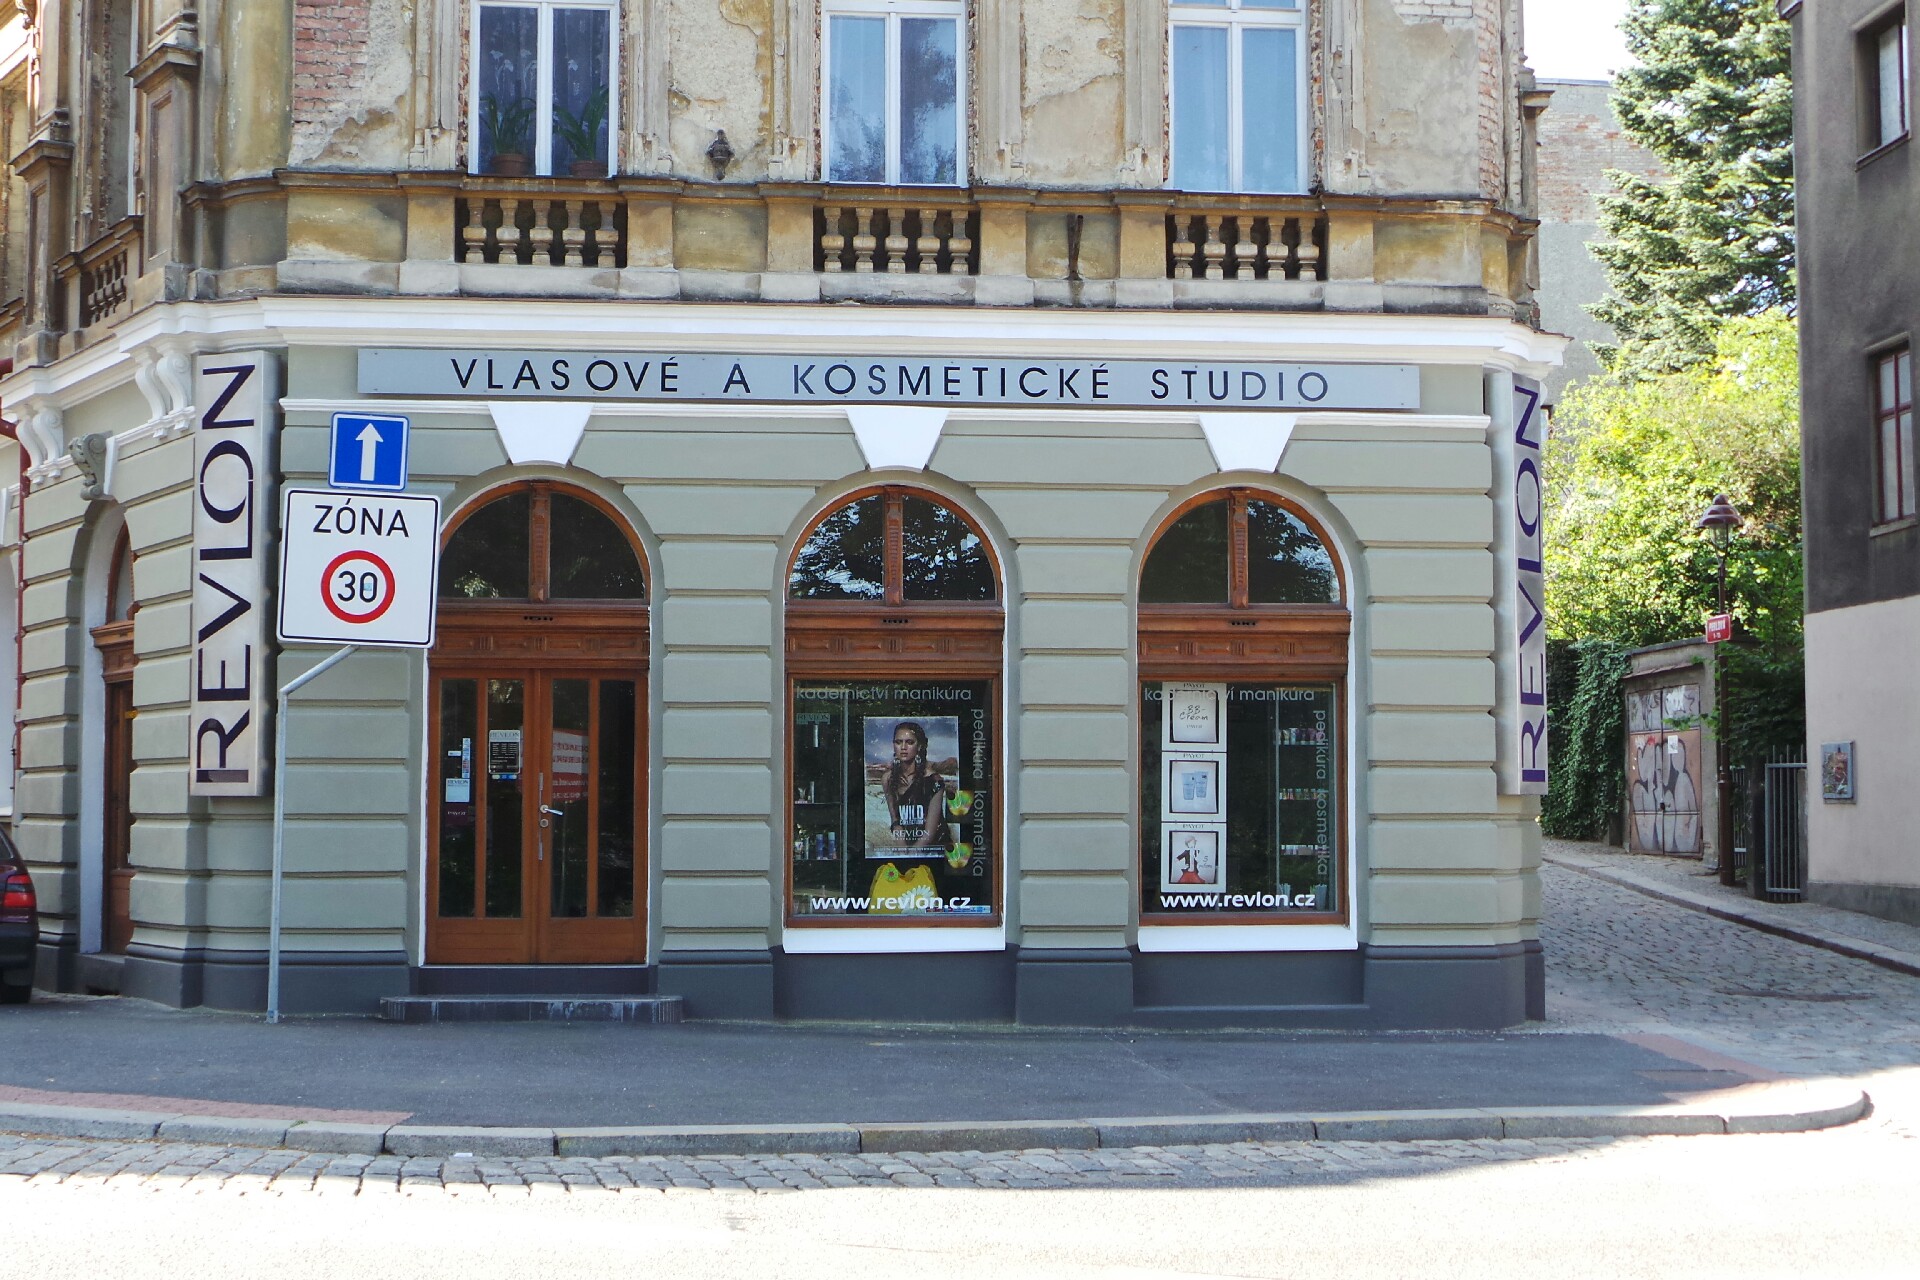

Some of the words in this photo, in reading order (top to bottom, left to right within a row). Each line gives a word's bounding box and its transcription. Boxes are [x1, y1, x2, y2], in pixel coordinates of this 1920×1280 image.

[450, 356, 679, 392] VLASOVÉ
[722, 363, 752, 394] A
[793, 363, 1110, 399] KOSMETICKÉ
[1150, 369, 1329, 402] STUDIO
[312, 498, 410, 538] ZÓNA
[196, 364, 256, 784] REVLON
[336, 570, 379, 603] 30
[1514, 384, 1547, 783] REVLON
[796, 684, 889, 700] kadeřnictví
[893, 686, 972, 700] manikúra
[1239, 686, 1315, 701] manikúra
[970, 709, 987, 779] pedikúra
[1313, 710, 1329, 780] pedikúra
[898, 804, 924, 821] WILD
[1316, 788, 1330, 875] kosmetika
[892, 828, 930, 838] REVLON
[972, 790, 988, 877] kosmetika
[811, 894, 971, 910] www.revlon.cz
[1160, 891, 1316, 908] www.revlon.cz
